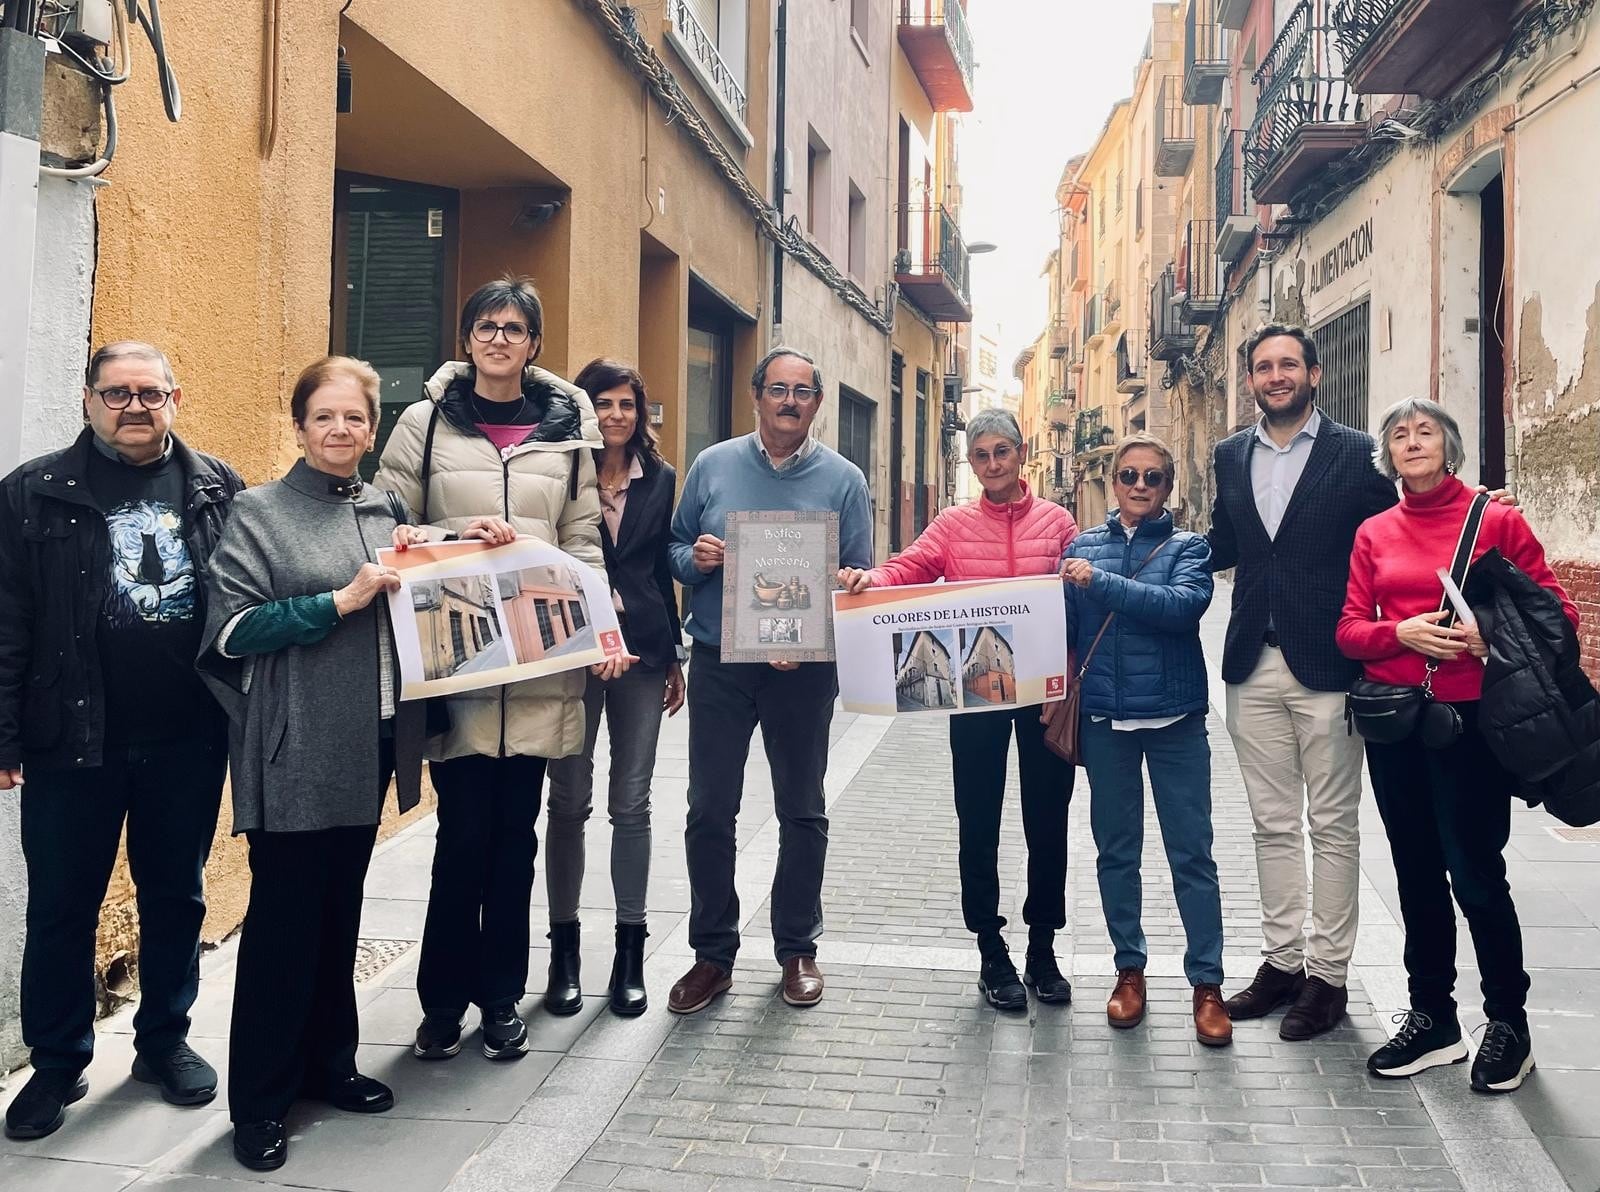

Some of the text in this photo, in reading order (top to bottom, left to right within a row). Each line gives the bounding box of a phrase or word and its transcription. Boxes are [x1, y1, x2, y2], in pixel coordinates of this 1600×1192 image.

[1309, 216, 1373, 298] ALIMENTACION
[764, 528, 801, 539] Botica
[776, 542, 787, 553] &
[873, 611, 931, 625] COLORES
[934, 610, 951, 620] DE
[953, 608, 969, 619] LA
[970, 604, 1030, 618] HISTORIA
